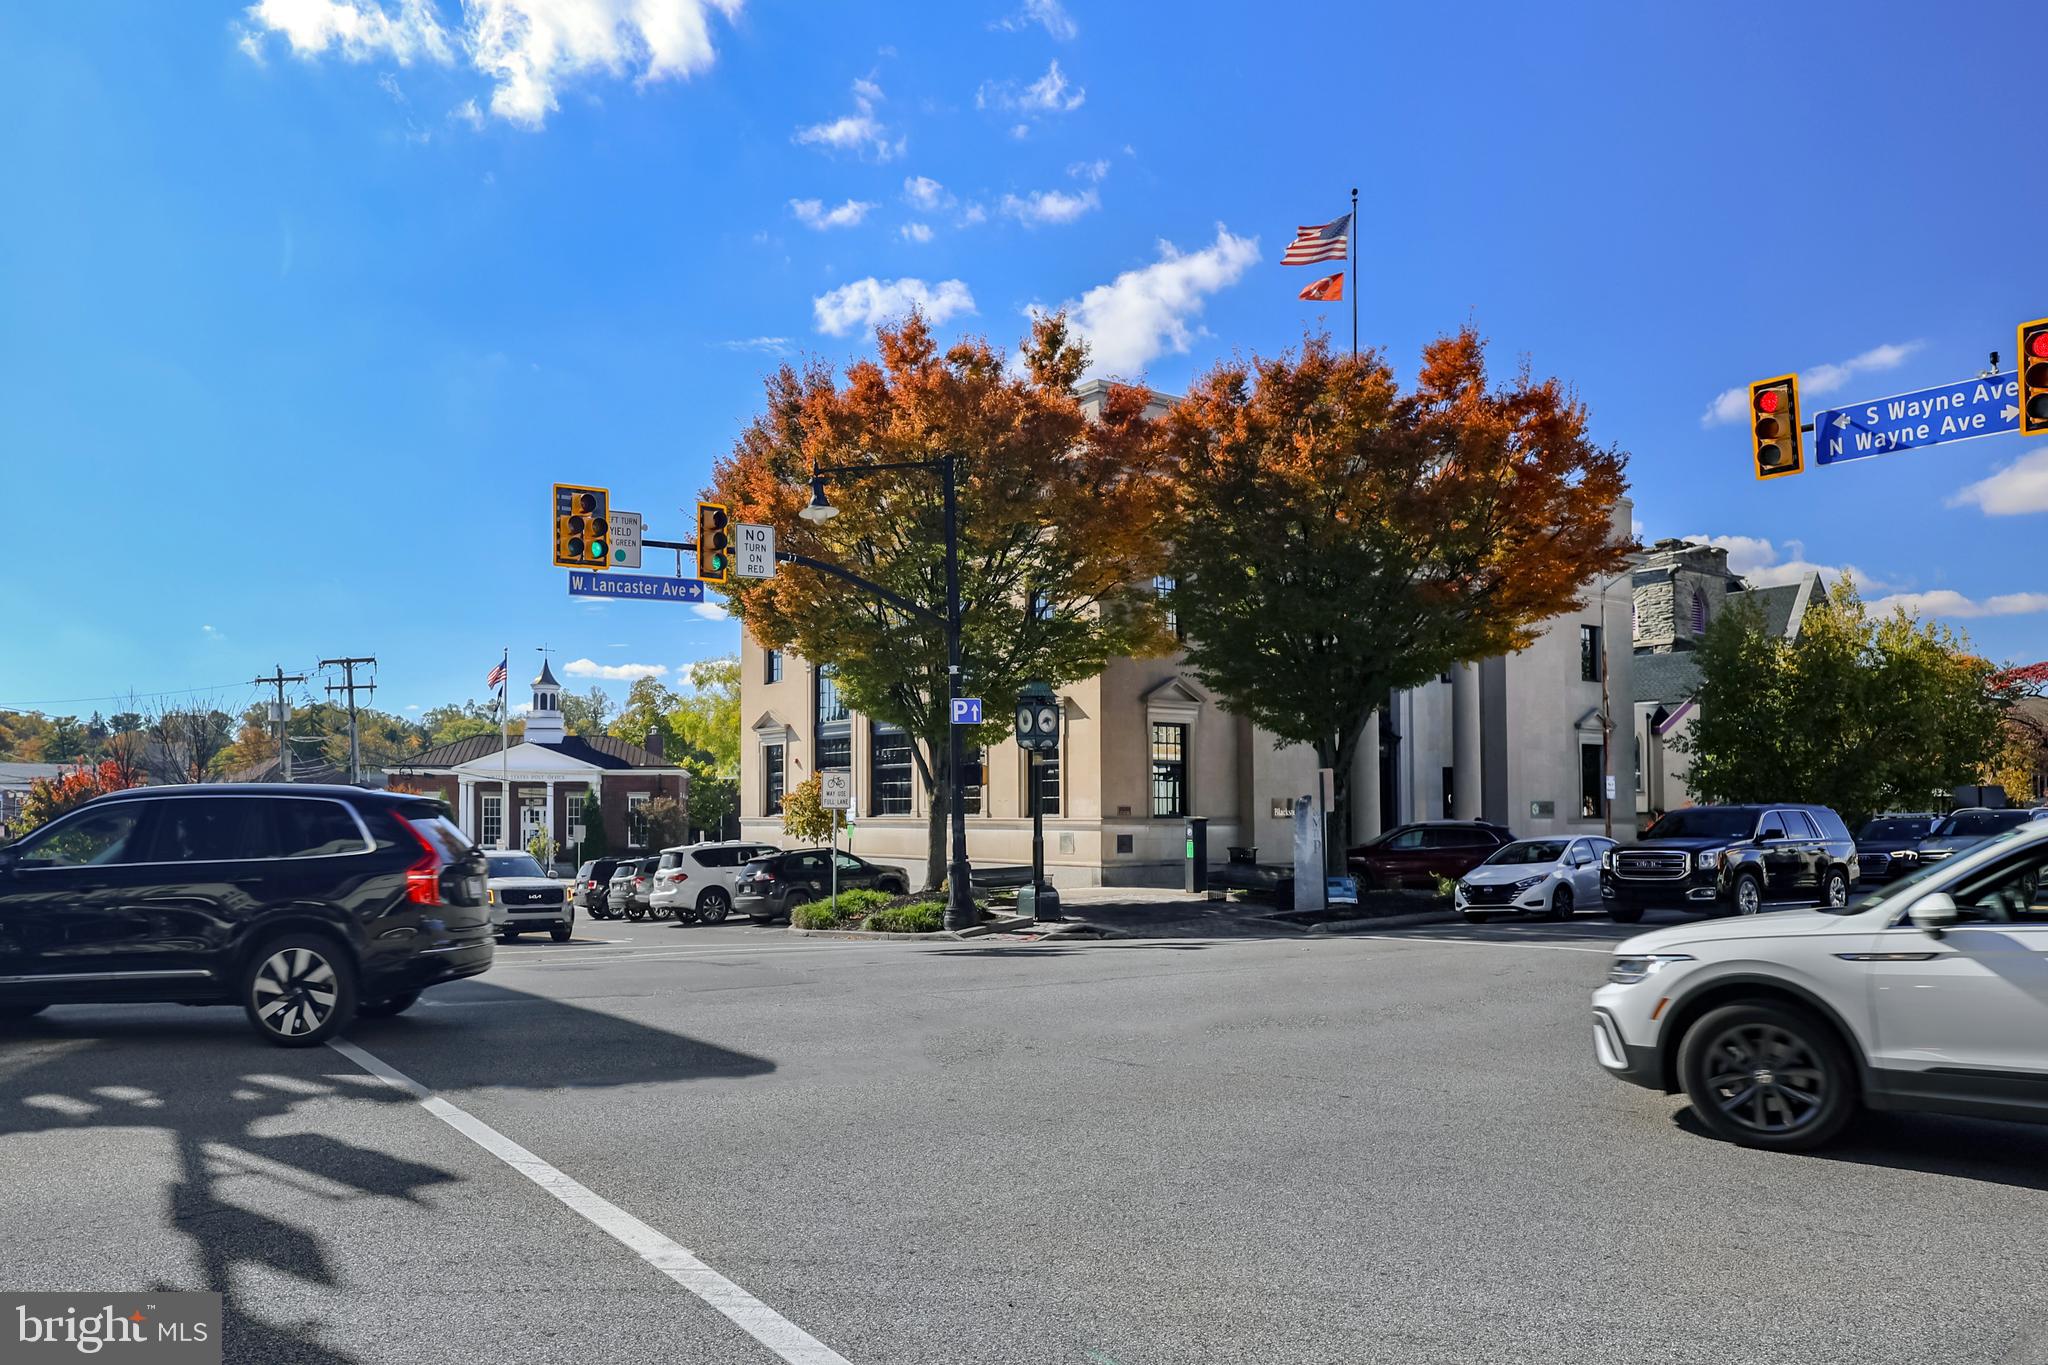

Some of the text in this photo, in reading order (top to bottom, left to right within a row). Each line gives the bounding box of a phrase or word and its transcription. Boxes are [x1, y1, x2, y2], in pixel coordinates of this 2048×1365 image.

[1866, 381, 2019, 425] S Wayne Ave
[1829, 412, 1986, 457] N Wayne Ave
[621, 517, 638, 525] TURN
[610, 527, 632, 536] YIELD
[745, 529, 765, 542] NO
[615, 538, 637, 547] GREEN
[744, 543, 767, 552] TURN
[749, 554, 762, 563] ON
[747, 564, 765, 574] RED
[572, 576, 686, 597] W. Lancaster Ave
[953, 701, 968, 721] P
